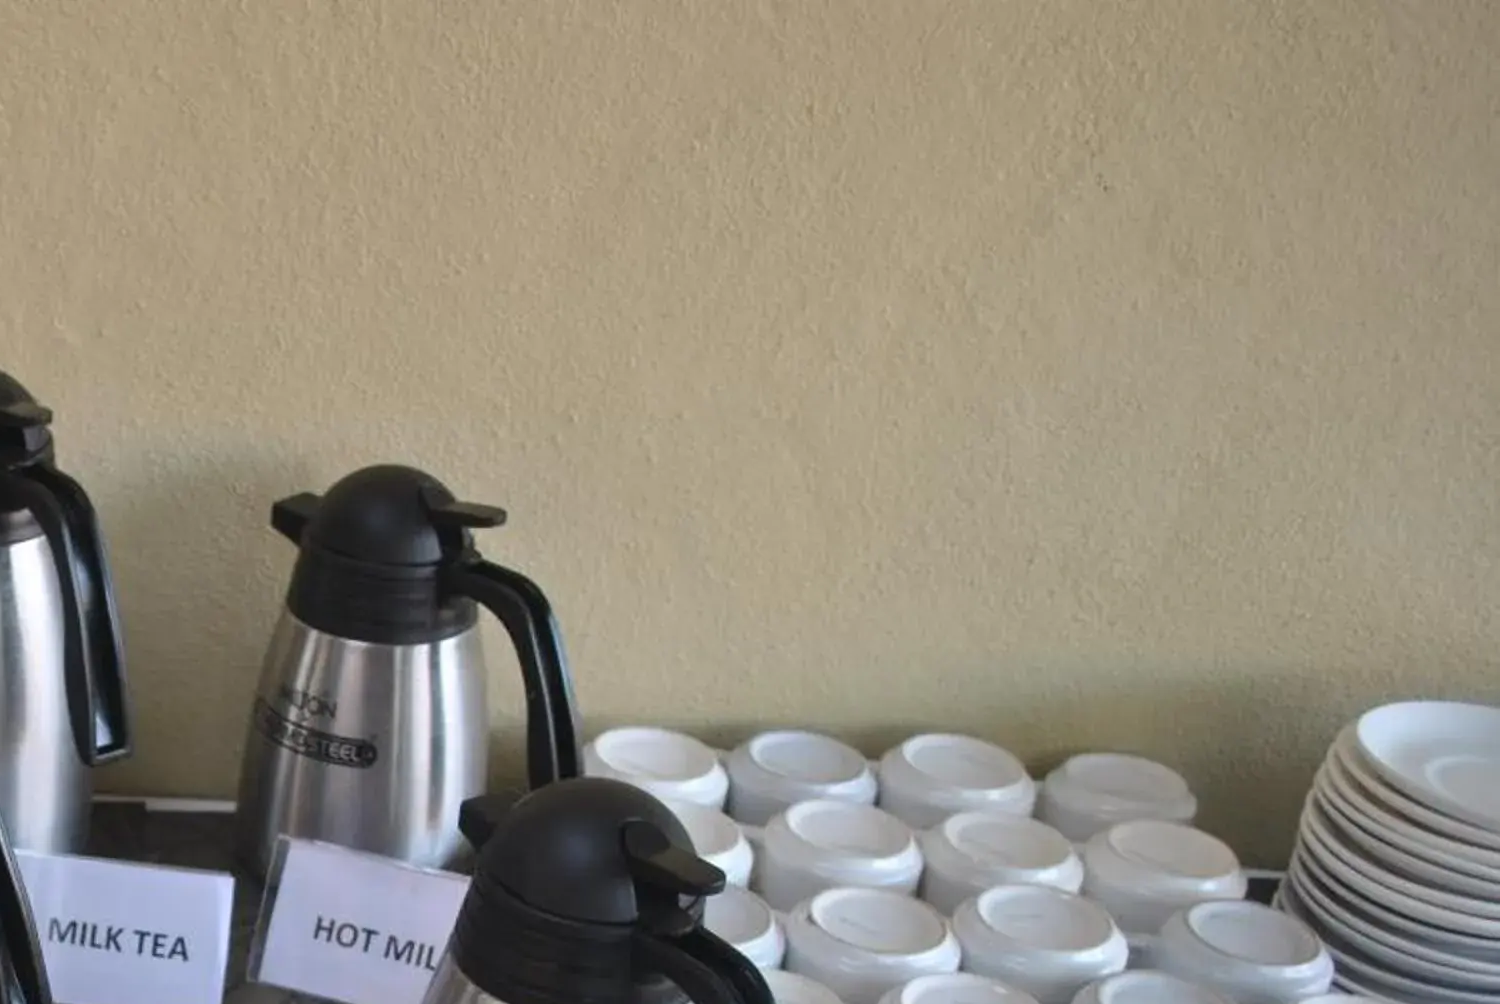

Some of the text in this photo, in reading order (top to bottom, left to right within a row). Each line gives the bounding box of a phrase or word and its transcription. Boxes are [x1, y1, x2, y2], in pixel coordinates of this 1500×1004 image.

[47, 916, 190, 962] MILK TEA
[312, 915, 438, 972] HOT MIL
